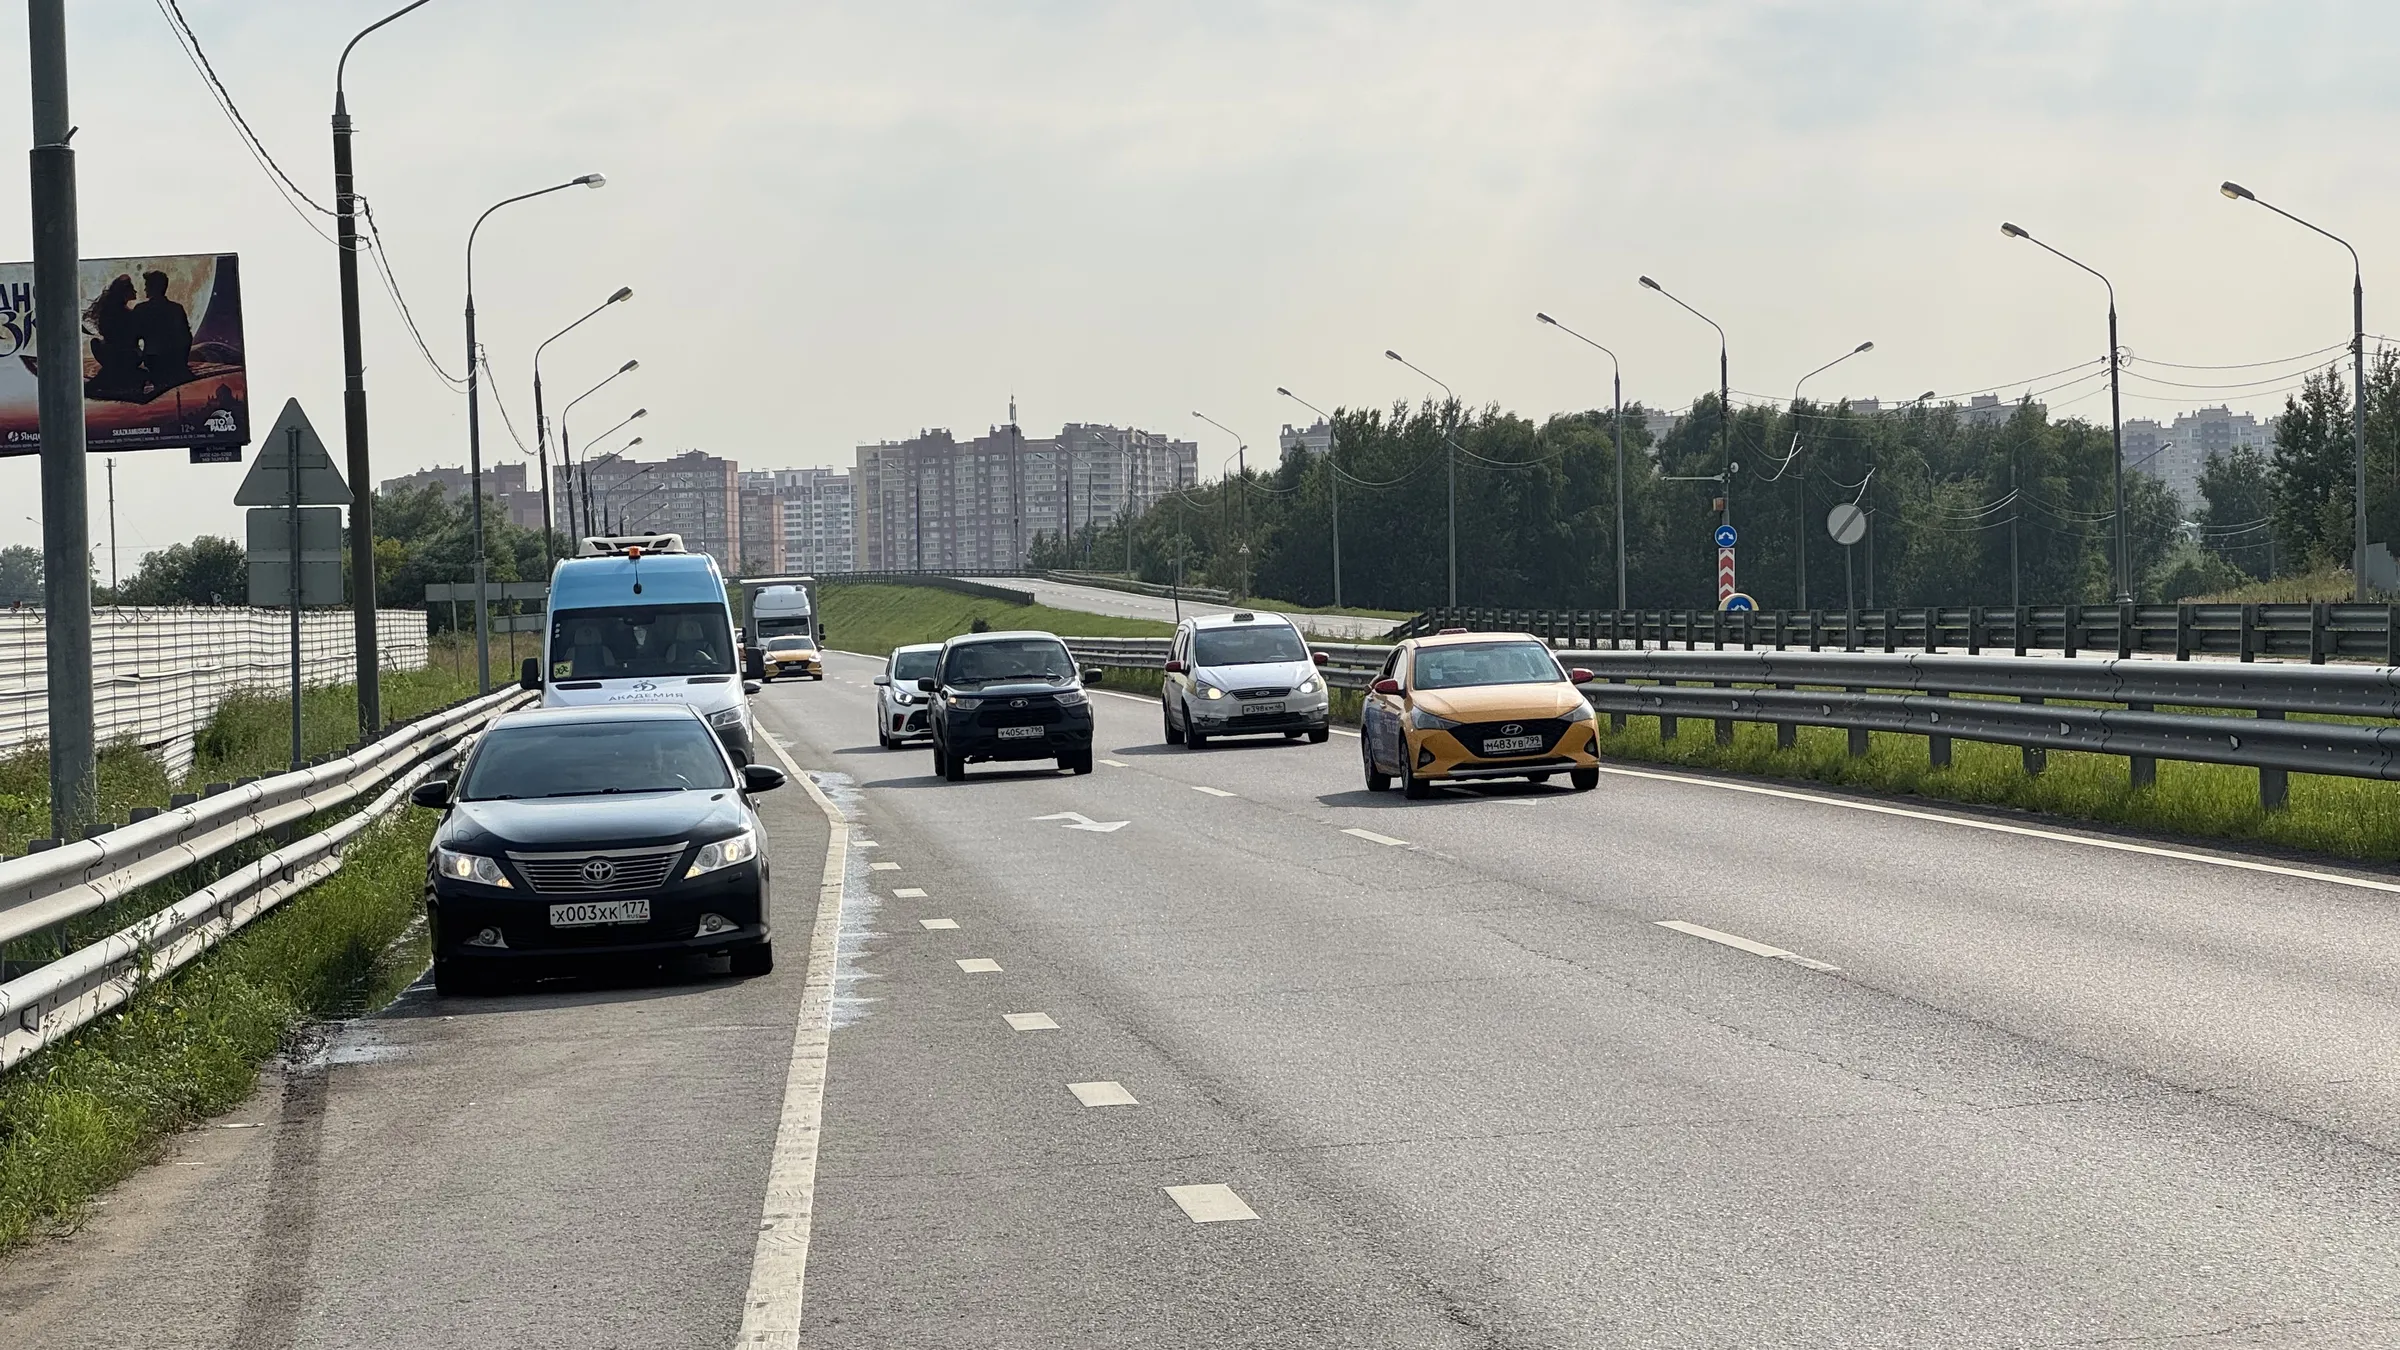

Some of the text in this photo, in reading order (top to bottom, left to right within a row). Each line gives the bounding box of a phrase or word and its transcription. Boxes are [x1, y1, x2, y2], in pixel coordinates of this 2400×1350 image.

[204, 418, 225, 426] АВТО
[112, 427, 160, 436] SKAZKAMUSICAL.RU
[181, 424, 195, 433] 12+
[210, 424, 237, 432] РАДИО
[609, 693, 683, 701] АКАДЕМИЯ
[556, 901, 645, 922] Х003ХК 177
